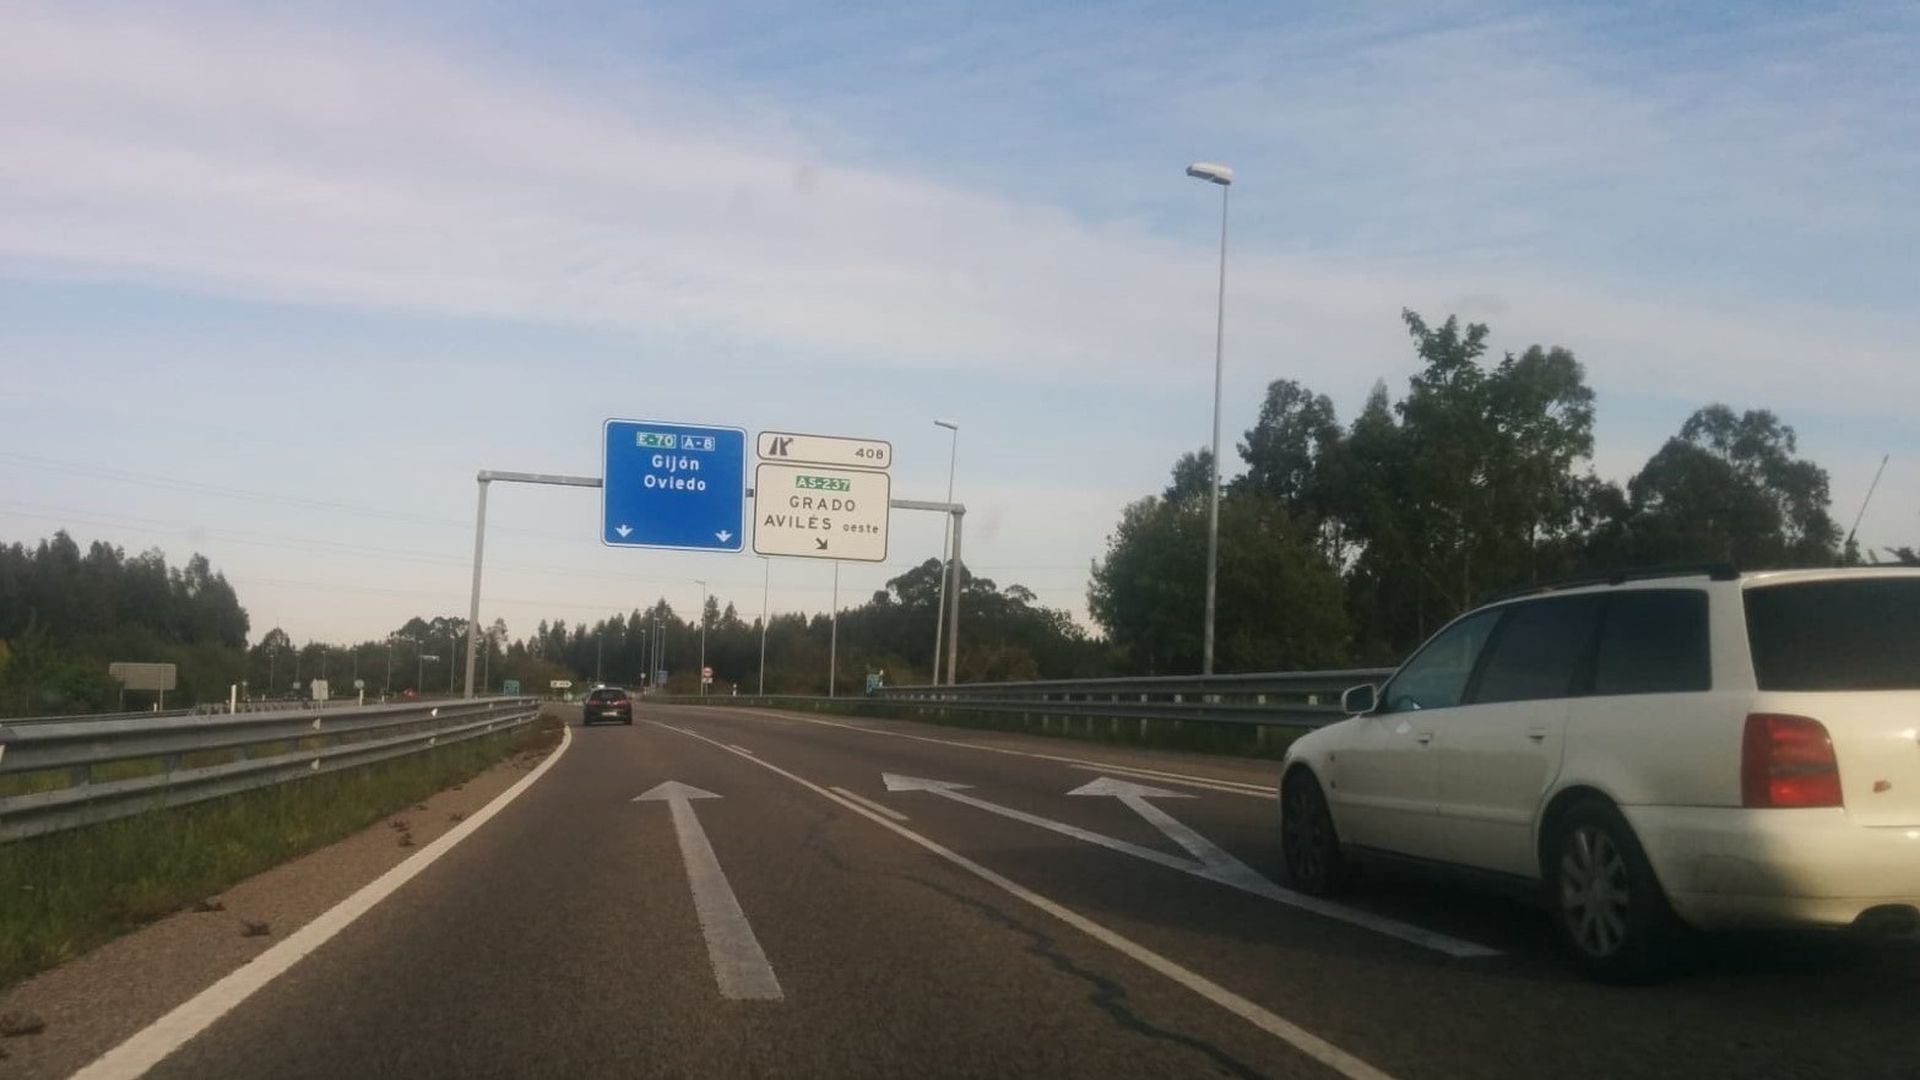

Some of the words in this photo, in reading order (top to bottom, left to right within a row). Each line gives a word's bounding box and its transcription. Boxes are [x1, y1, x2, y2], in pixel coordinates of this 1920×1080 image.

[639, 433, 674, 447] E-70
[684, 436, 713, 450] A-8
[855, 448, 884, 460] 408
[652, 454, 700, 473] Gijón
[644, 474, 706, 491] Oviedo
[798, 477, 849, 491] AS-237
[789, 495, 856, 512] GRADO
[764, 513, 832, 530] AVILÉS
[843, 523, 879, 534] oeste
